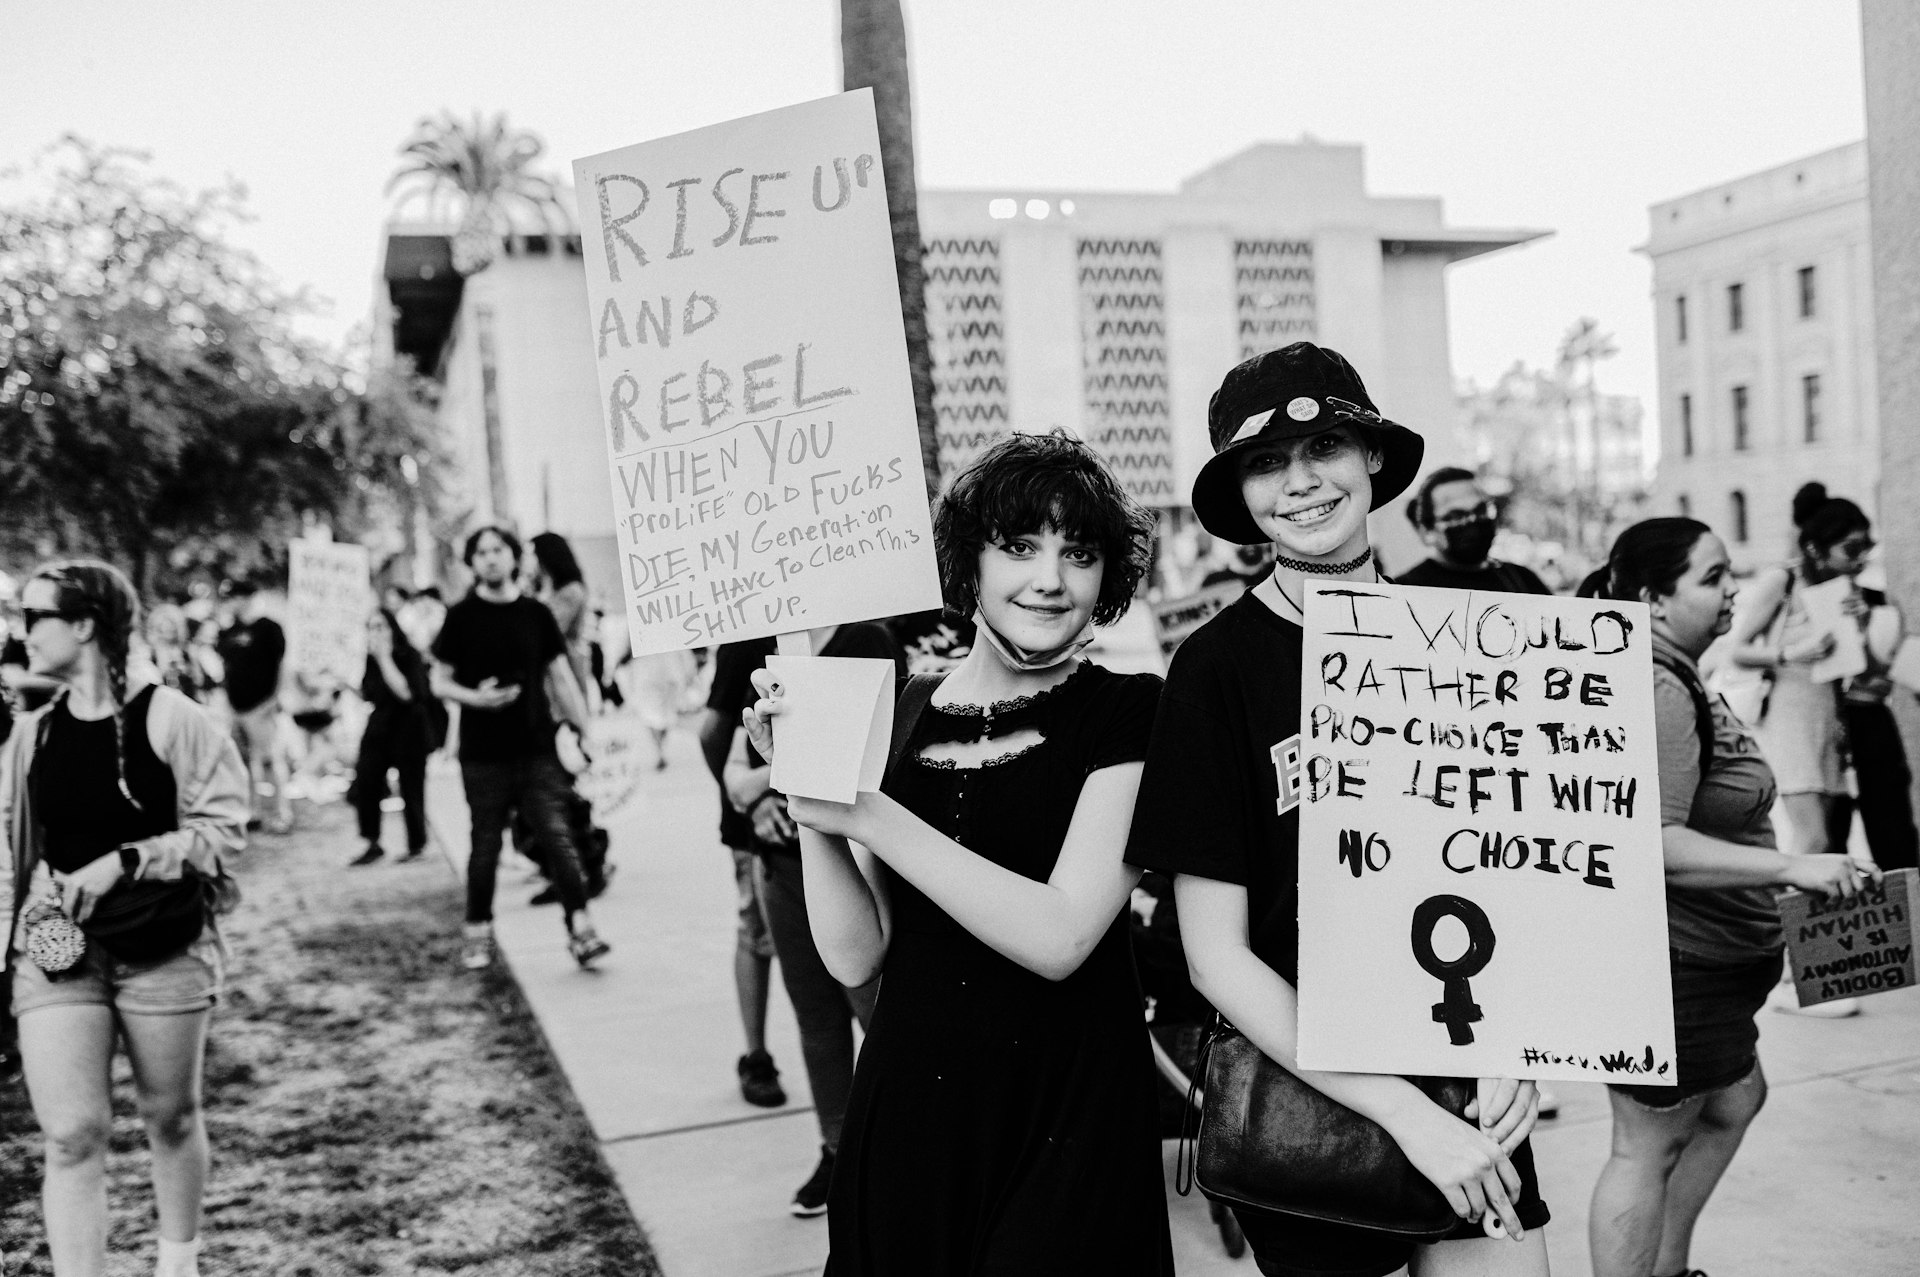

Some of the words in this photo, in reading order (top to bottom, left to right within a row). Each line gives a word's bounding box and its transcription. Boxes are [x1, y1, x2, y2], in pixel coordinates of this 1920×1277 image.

[595, 167, 791, 283] RISE
[812, 153, 874, 212] UP
[598, 290, 721, 359] AND
[609, 342, 858, 452] REBEL
[617, 438, 737, 509] WHEN
[753, 419, 834, 485] YOU
[744, 485, 800, 516] OLD
[810, 456, 903, 515] FUCKS
[700, 529, 739, 572] MY
[751, 504, 892, 554] Generation
[636, 590, 704, 625] WILL
[809, 539, 874, 568] Clean
[875, 527, 920, 551] This
[682, 591, 762, 646] SHIT
[764, 596, 807, 624] UP.
[1316, 589, 1393, 639] I
[1405, 591, 1633, 659] WOULD
[1320, 651, 1518, 710] RATHER
[1544, 667, 1614, 707] BE
[1310, 704, 1523, 757] PRO-CHOICE
[1536, 722, 1626, 755] THAN
[1305, 753, 1370, 803] BE
[1402, 760, 1529, 814] LEFT
[1548, 773, 1637, 818] WITH
[1338, 828, 1391, 878] NO
[1441, 828, 1615, 889] CHOICE
[1800, 904, 1904, 943] HUMAN
[1837, 934, 1853, 951] A
[1866, 928, 1889, 946] IS
[1801, 944, 1911, 982] AUTONOMY
[1821, 967, 1905, 999] BODILY
